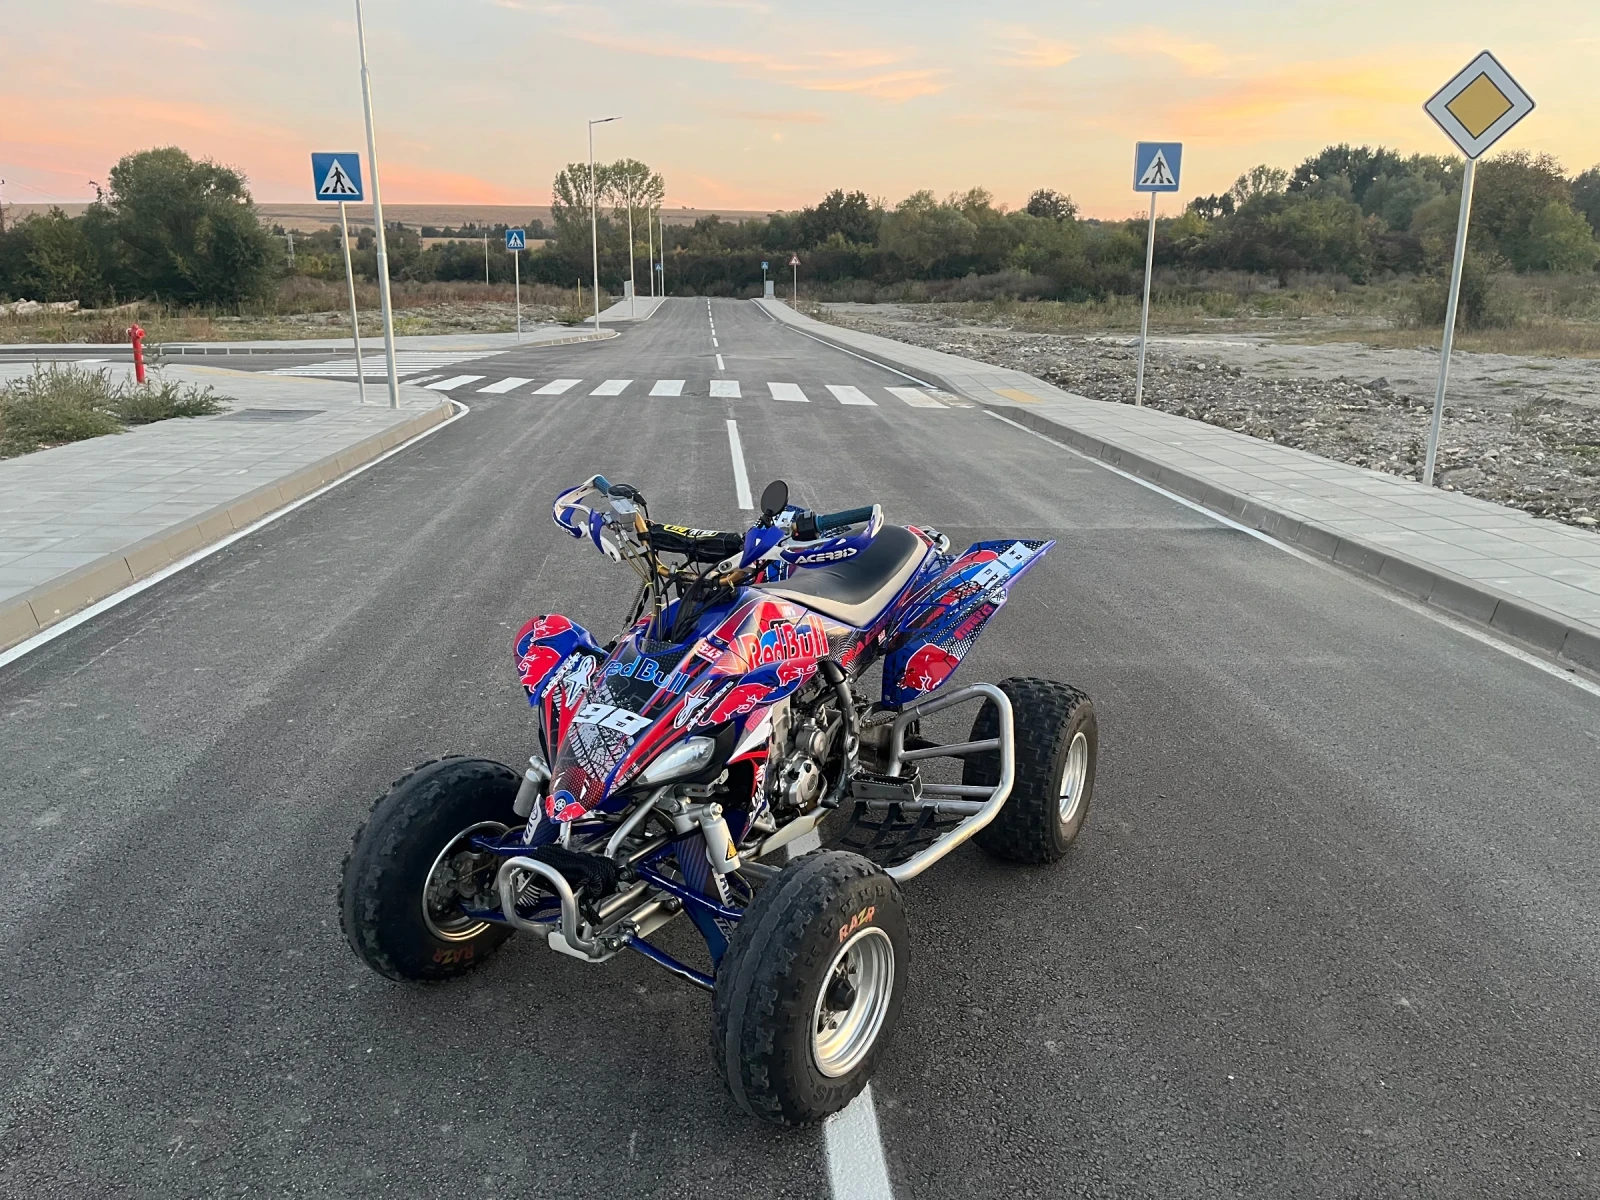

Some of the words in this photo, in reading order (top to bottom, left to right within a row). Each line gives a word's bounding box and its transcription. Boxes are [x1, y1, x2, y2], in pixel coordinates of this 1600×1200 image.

[795, 547, 858, 564] ACERBIS
[781, 614, 829, 660] Bull
[635, 657, 690, 694] Bull
[838, 905, 876, 943] RAZR
